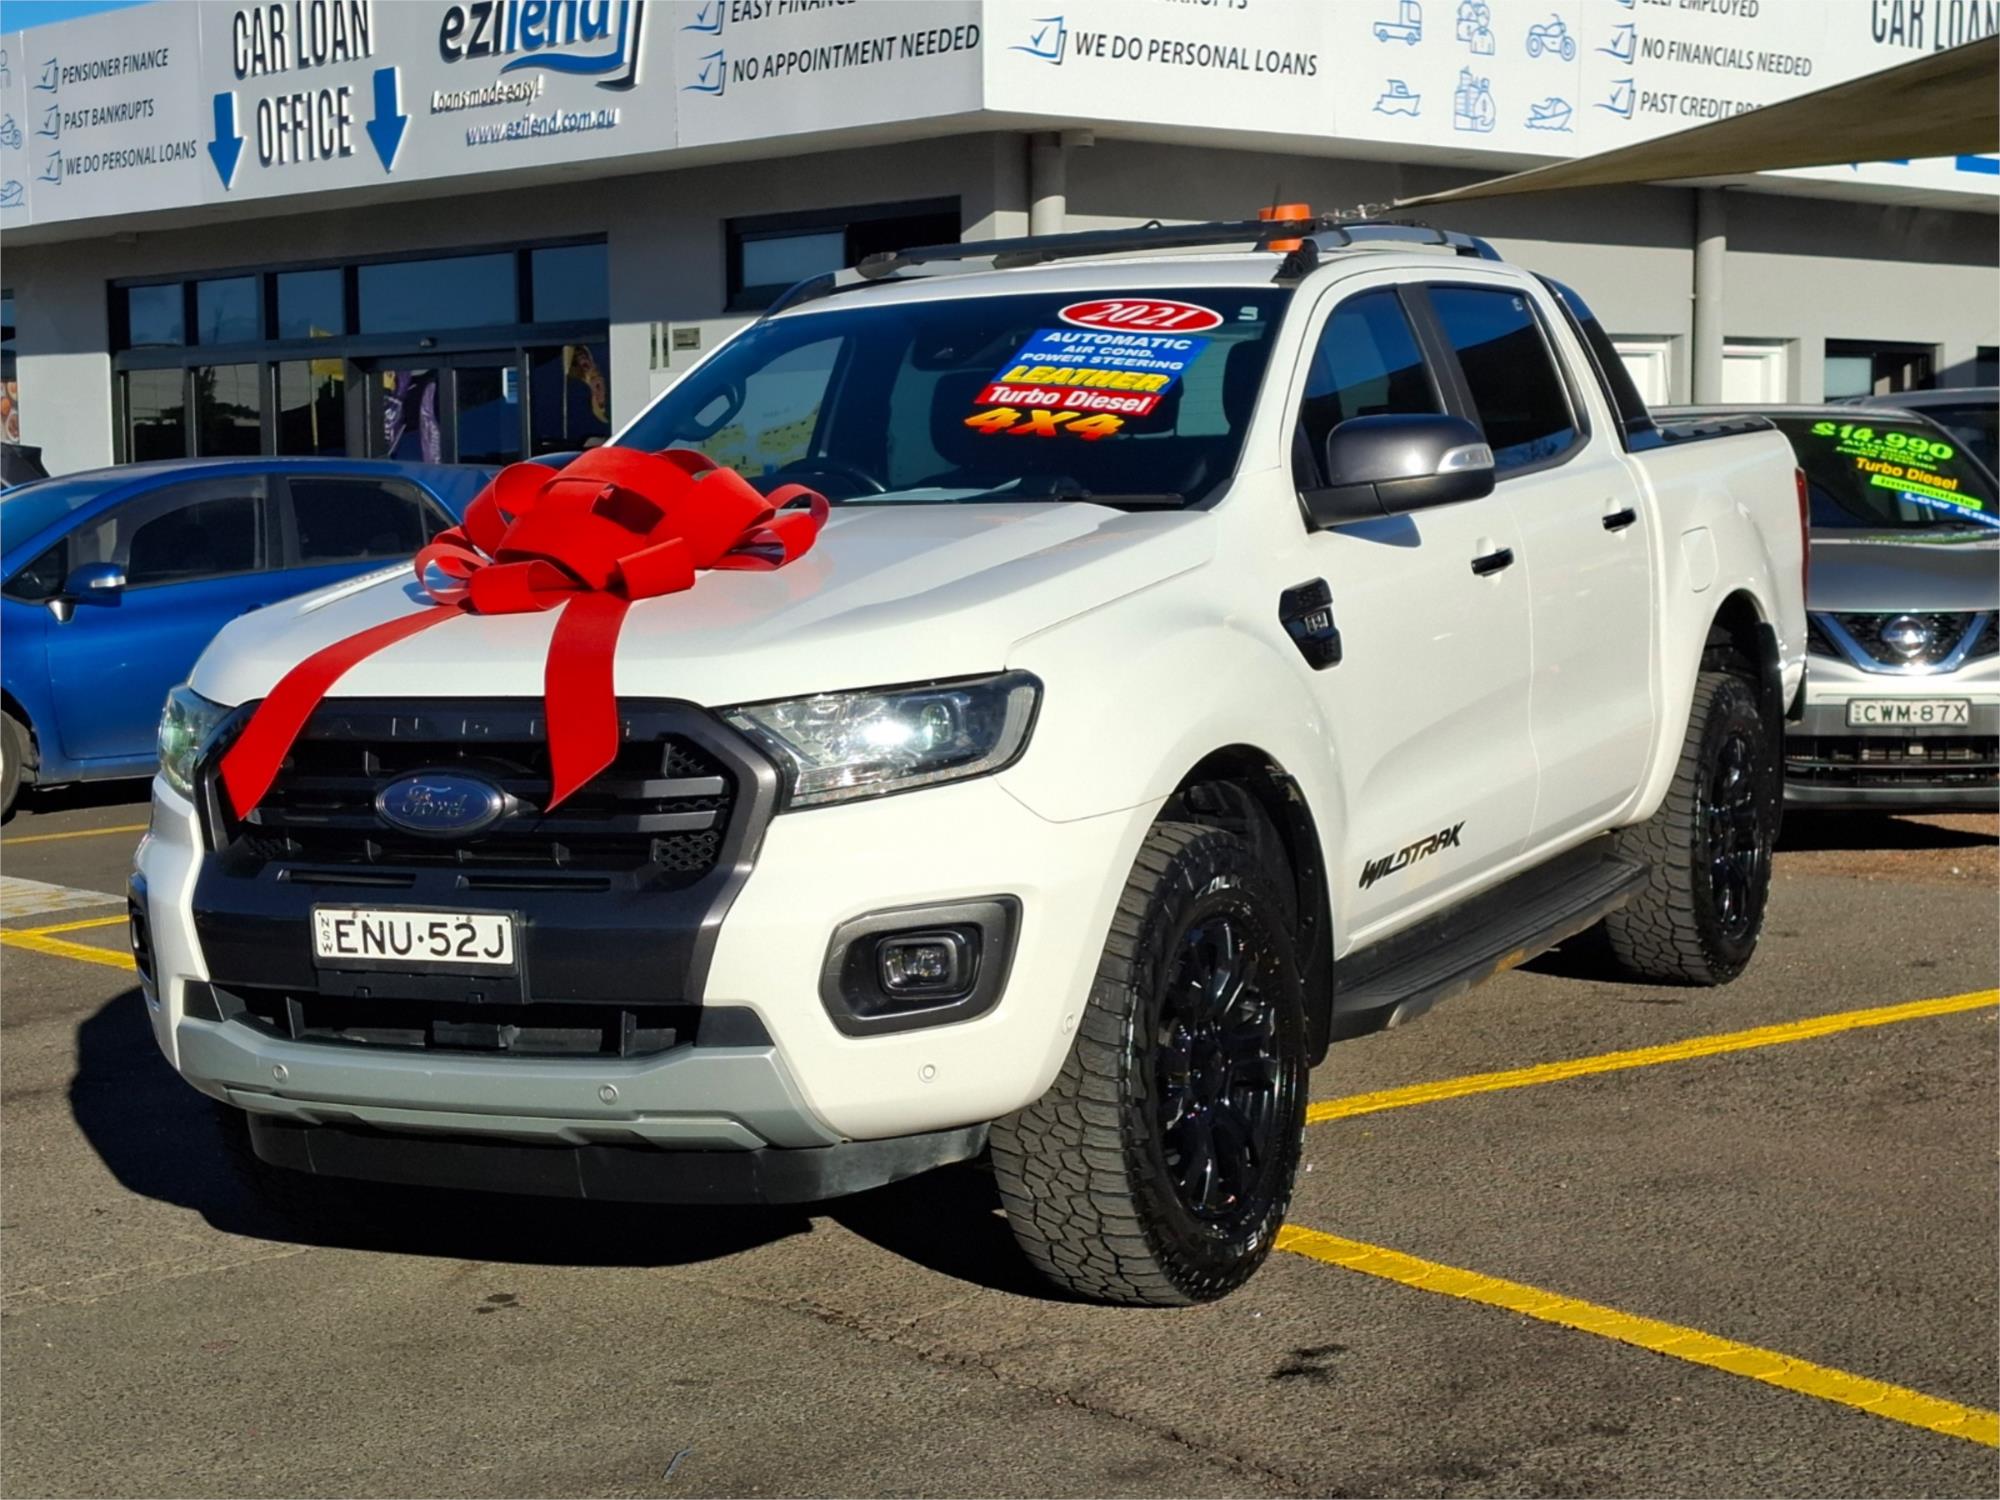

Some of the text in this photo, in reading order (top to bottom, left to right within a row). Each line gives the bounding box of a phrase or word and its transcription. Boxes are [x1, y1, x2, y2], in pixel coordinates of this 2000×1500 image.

[731, 0, 773, 22] EASY
[1872, 0, 1924, 50] CAR
[233, 0, 373, 80] CAR LOAN
[732, 24, 981, 83] NO APPOINTMENT NEEDED
[1075, 32, 1318, 76] WE DO PERSONAL LOANS
[62, 48, 169, 85] PENSIONER FINANCE
[1642, 38, 1813, 77] NO FINANCIALS NEEDED
[431, 90, 466, 114] Loans
[468, 80, 507, 108] made
[1640, 91, 1678, 114] PAST
[1680, 95, 1733, 120] CREDIT
[64, 98, 155, 130] PAST BANKRUPTS
[257, 86, 354, 168] OFFICE
[466, 108, 620, 147] www.ezilend.com.au
[66, 140, 197, 176] WE DO PERSONAL LOANS
[1078, 302, 1200, 328] 2021
[1043, 332, 1193, 351] AUTOMATIC
[1062, 345, 1155, 359] AIR COND.
[1020, 352, 1184, 371] POWER STEERING
[1000, 365, 1170, 392] LEATHER
[988, 386, 1152, 413] Turbo Diesel
[1856, 457, 1959, 490] Turbo Diesel
[402, 784, 468, 817] Ford
[1359, 820, 1466, 890] WILDTRAK
